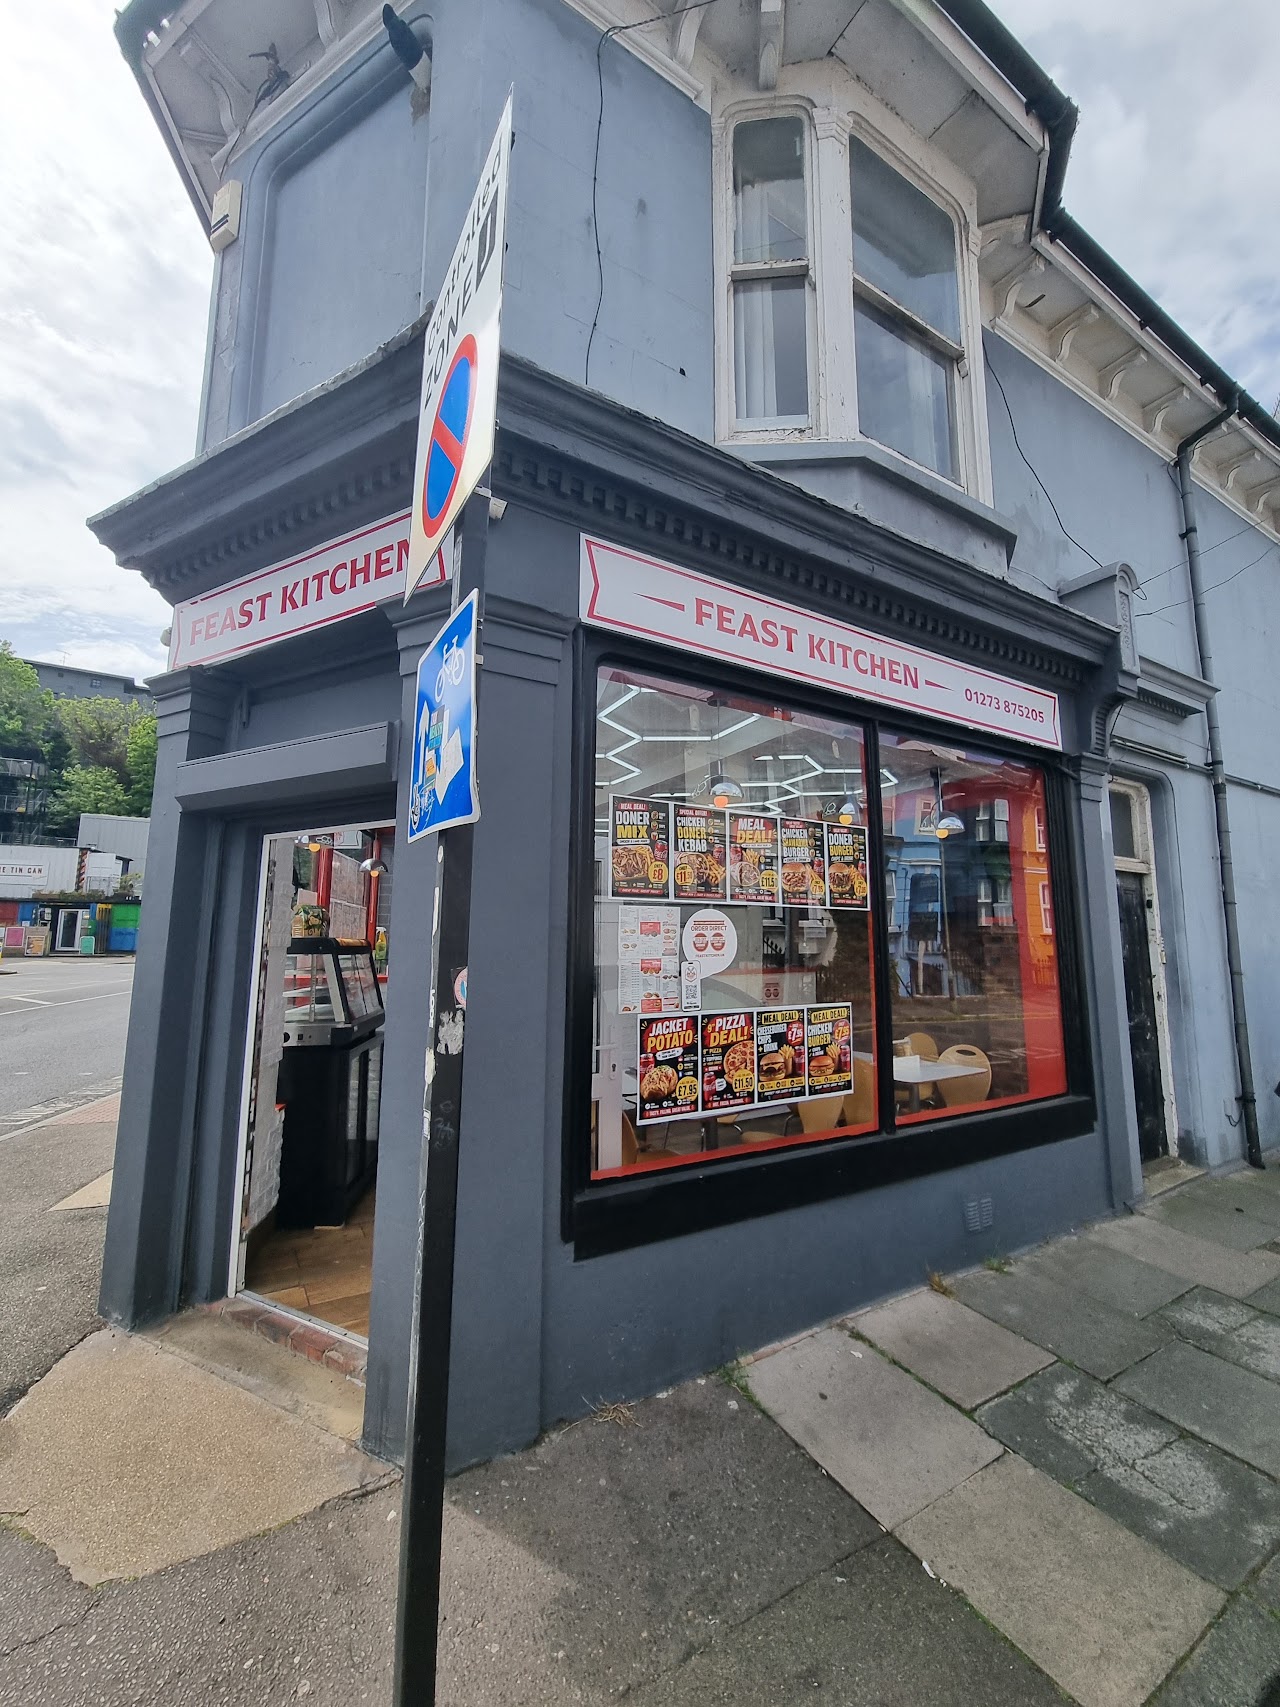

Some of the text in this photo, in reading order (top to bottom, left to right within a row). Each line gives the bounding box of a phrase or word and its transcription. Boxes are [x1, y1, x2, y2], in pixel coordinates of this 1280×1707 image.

[428, 132, 502, 356] Controlled
[424, 259, 474, 410] ZONE
[190, 592, 272, 646] FEAST
[695, 597, 919, 689] FEAST KITCHEN
[964, 688, 1045, 724] 01273 875205
[616, 810, 650, 825] DONER
[676, 816, 706, 827] CHICKEN
[738, 818, 766, 831] MEAL
[617, 825, 649, 838] MIX
[677, 826, 707, 839] DONER
[736, 830, 772, 843] DEAL!
[781, 828, 808, 838] CHICKEN
[678, 839, 707, 852] KEBAB
[828, 833, 853, 845] DONER
[783, 847, 809, 857] BURGER
[829, 845, 854, 856] BURGER
[653, 868, 663, 880] £8
[763, 1011, 797, 1024] MEAL DEAL!
[813, 1009, 846, 1022] MEAL DEAL!
[649, 1017, 689, 1037] JACKET
[715, 1014, 746, 1032] PIZZA
[808, 1022, 833, 1036] CHICKEN
[647, 1029, 693, 1053] POTATO
[709, 1026, 749, 1047] DEAL!
[758, 1035, 772, 1045] CHIPS
[808, 1034, 831, 1047] BURGER
[734, 1076, 753, 1090] £11.50
[678, 1084, 697, 1097] £7.95
